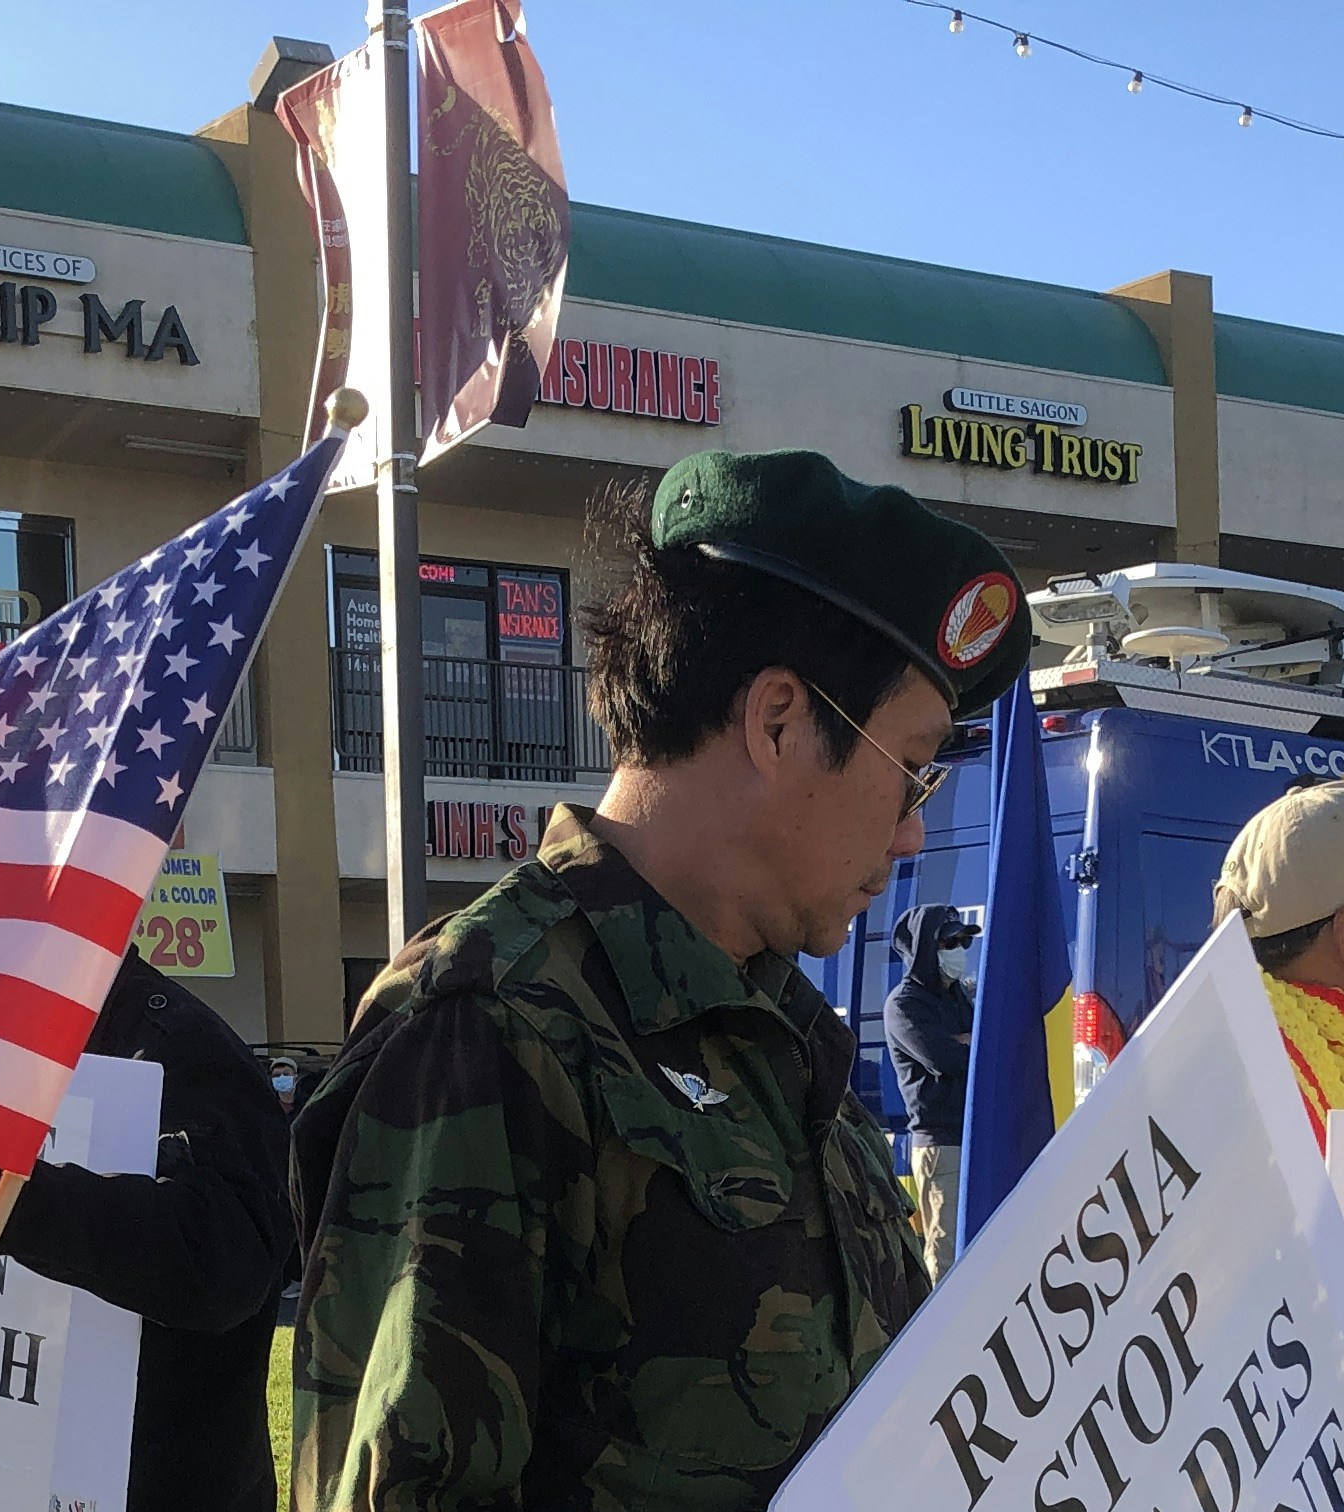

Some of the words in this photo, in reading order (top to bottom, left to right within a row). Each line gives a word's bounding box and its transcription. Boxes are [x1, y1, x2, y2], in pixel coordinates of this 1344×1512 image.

[53, 256, 83, 277] OF
[79, 293, 201, 367] MA
[958, 390, 1016, 414] LITTLE
[1020, 400, 1080, 422] SAIGON
[906, 404, 1027, 469] LIVING
[1033, 422, 1142, 484] TRUST
[346, 598, 378, 614] Auto
[499, 581, 557, 614] TAN'S
[346, 612, 381, 629] Home
[425, 800, 529, 861] INH'S
[159, 888, 169, 903] &
[171, 886, 217, 905] COLOR
